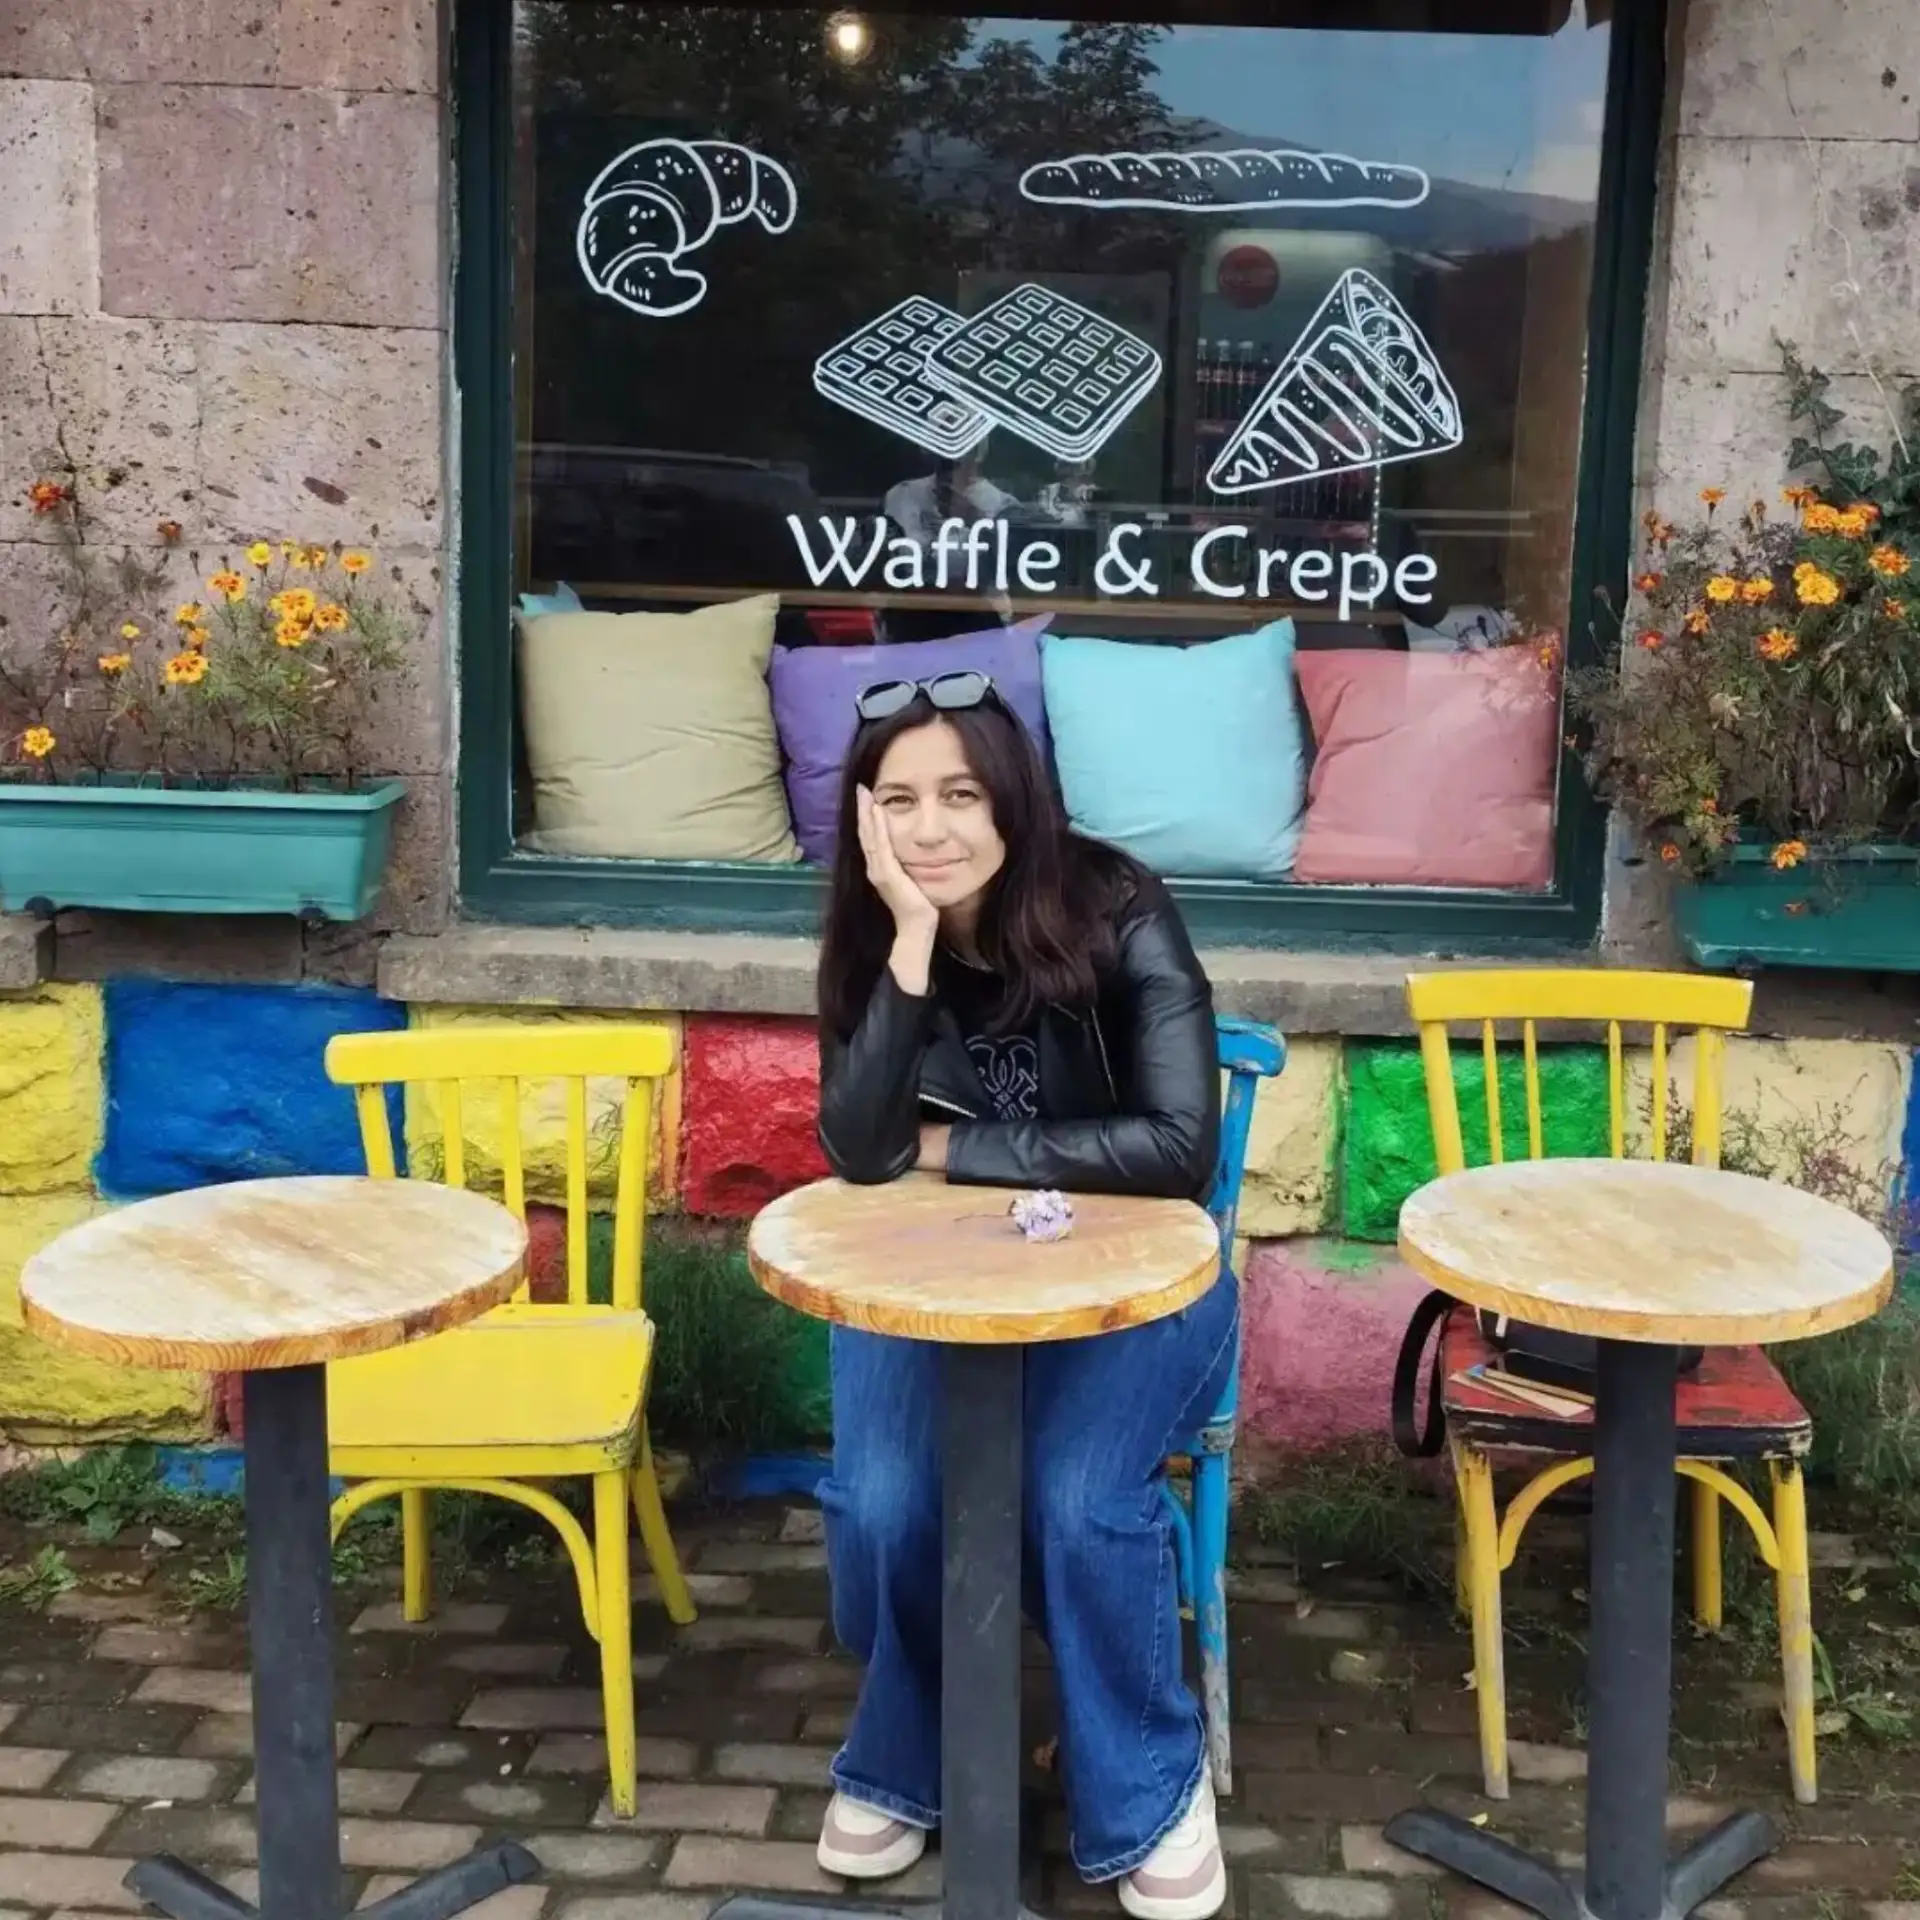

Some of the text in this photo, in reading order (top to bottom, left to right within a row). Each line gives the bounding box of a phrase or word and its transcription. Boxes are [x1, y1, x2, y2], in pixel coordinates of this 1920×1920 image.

[785, 514, 1438, 620] Waffle & Crepe
